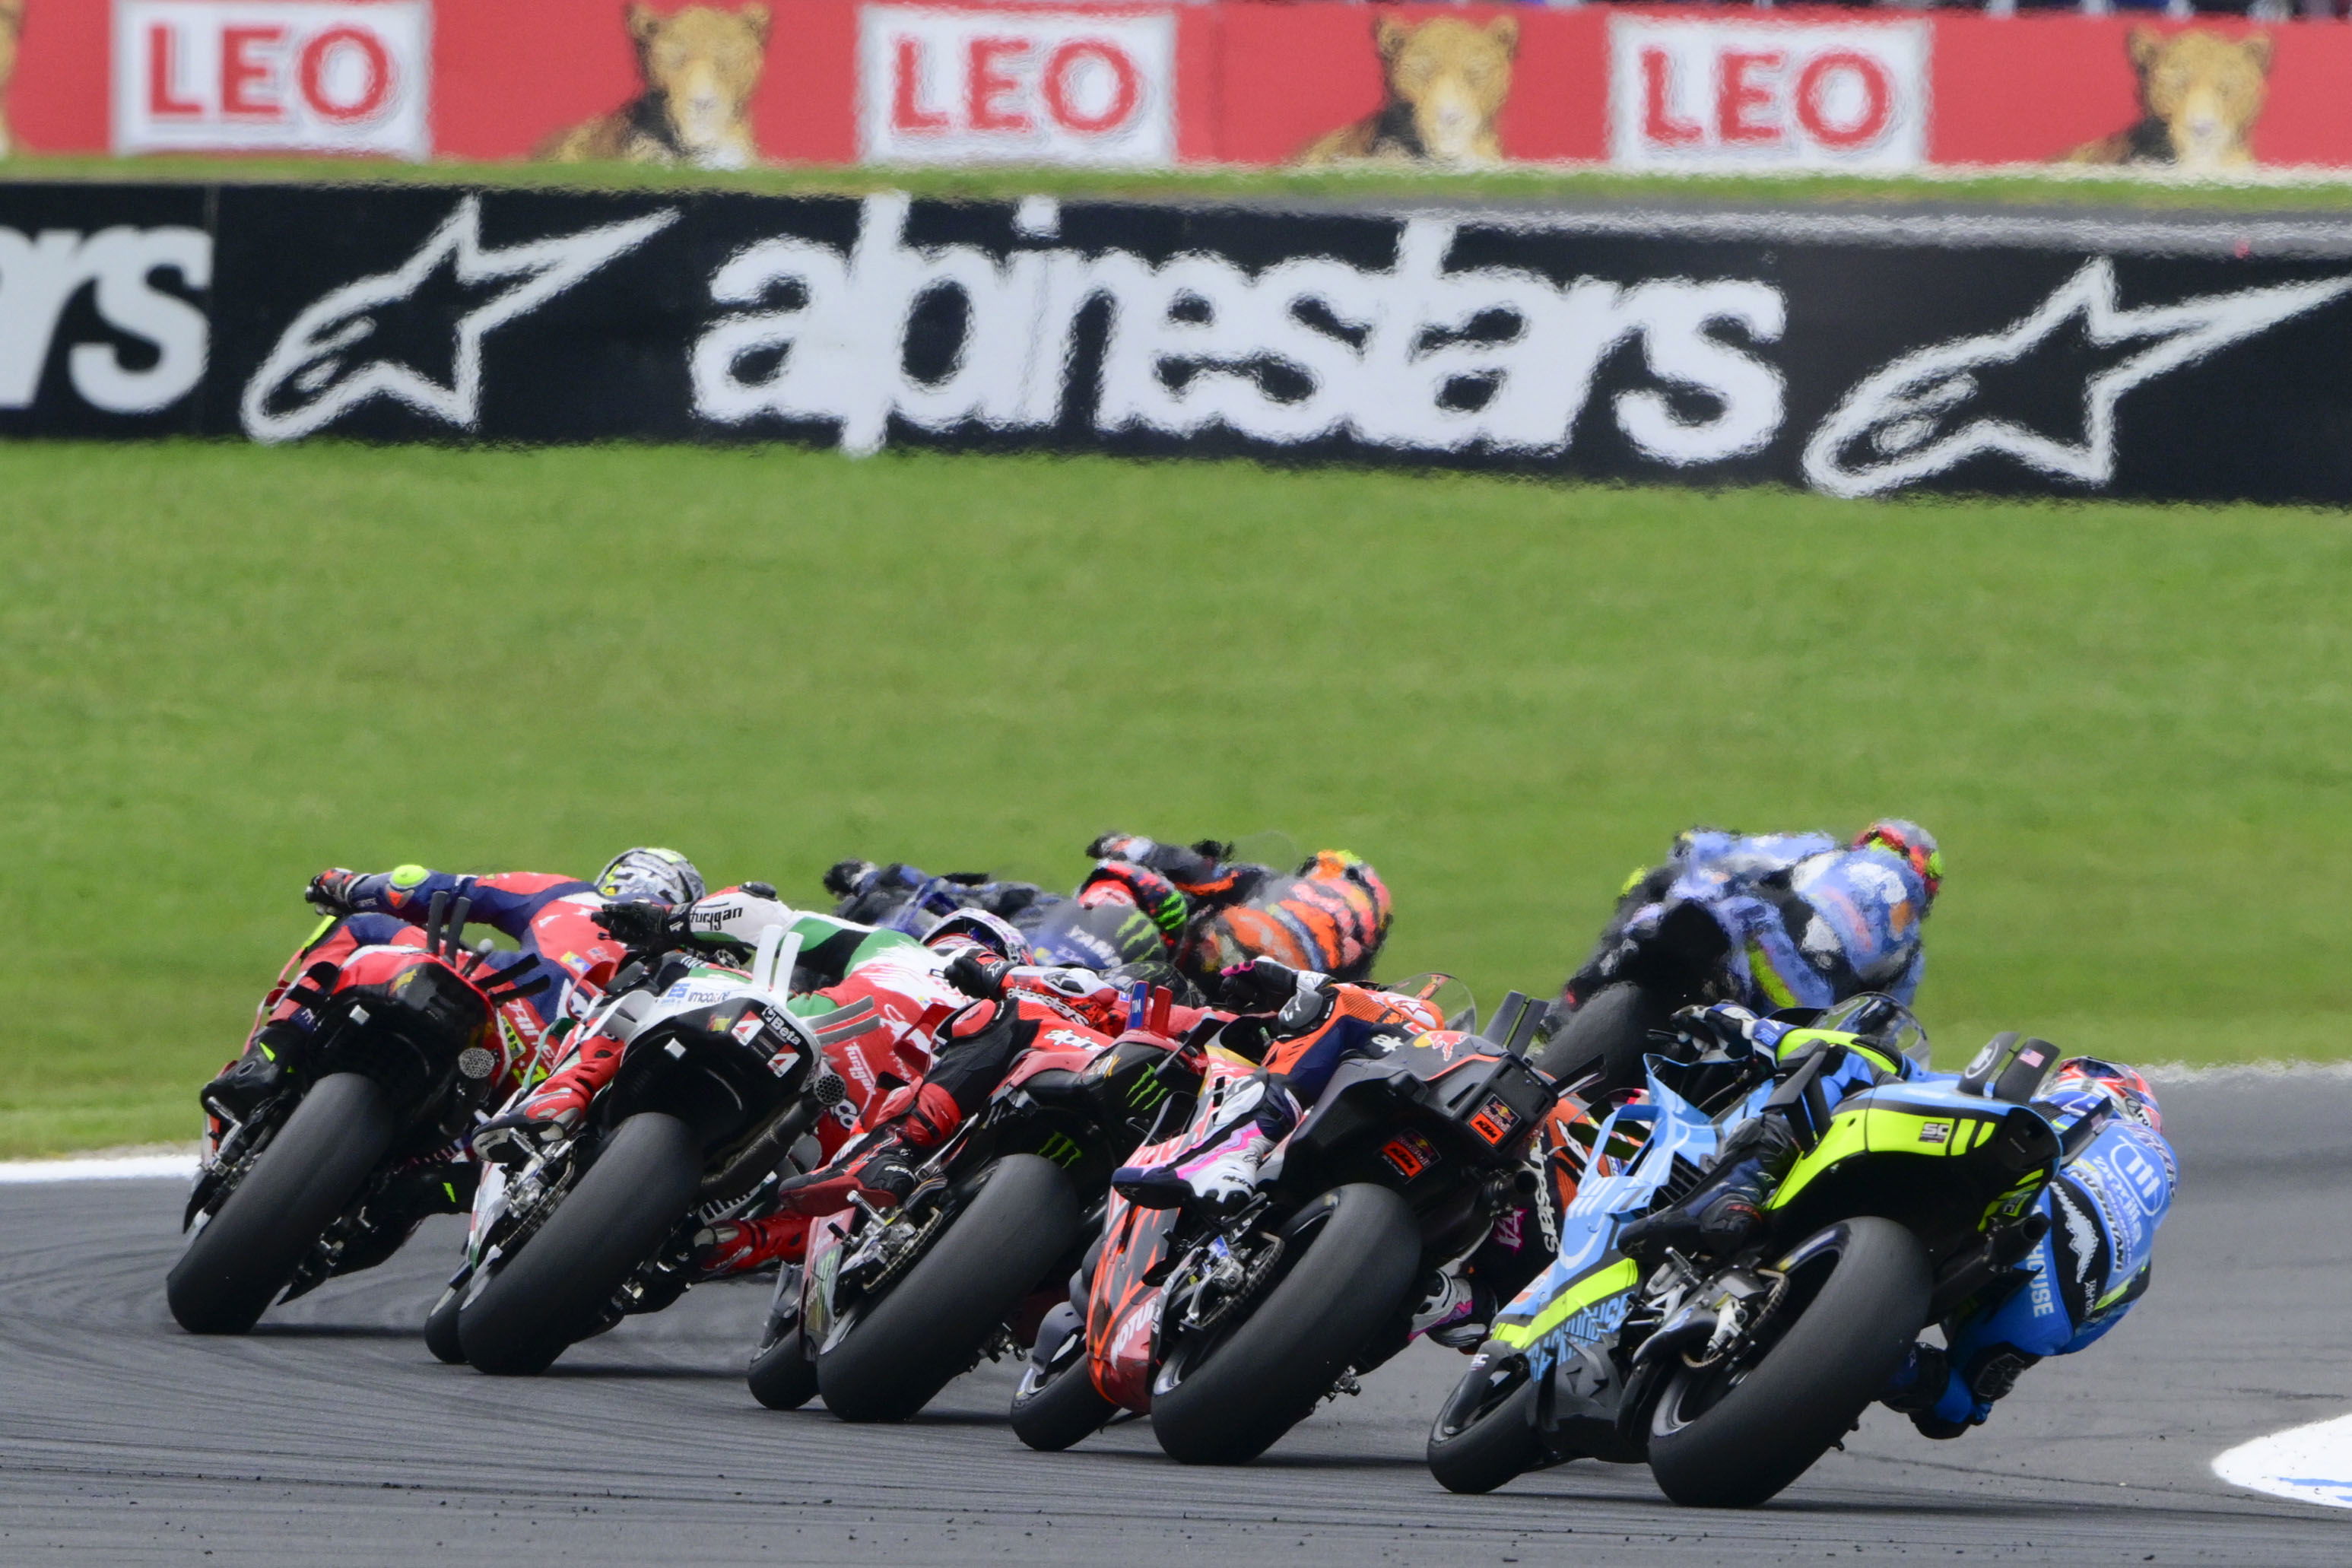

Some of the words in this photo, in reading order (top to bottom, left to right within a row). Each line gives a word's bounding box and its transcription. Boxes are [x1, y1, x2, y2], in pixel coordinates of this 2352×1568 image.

[151, 25, 392, 124] LEO
[891, 34, 1140, 135] LEO
[1640, 49, 1893, 148] LEO
[690, 190, 1787, 465] alpinestars
[772, 1016, 801, 1046] Beta
[1475, 1119, 1498, 1139] KTM
[1922, 1122, 1950, 1135] SC
